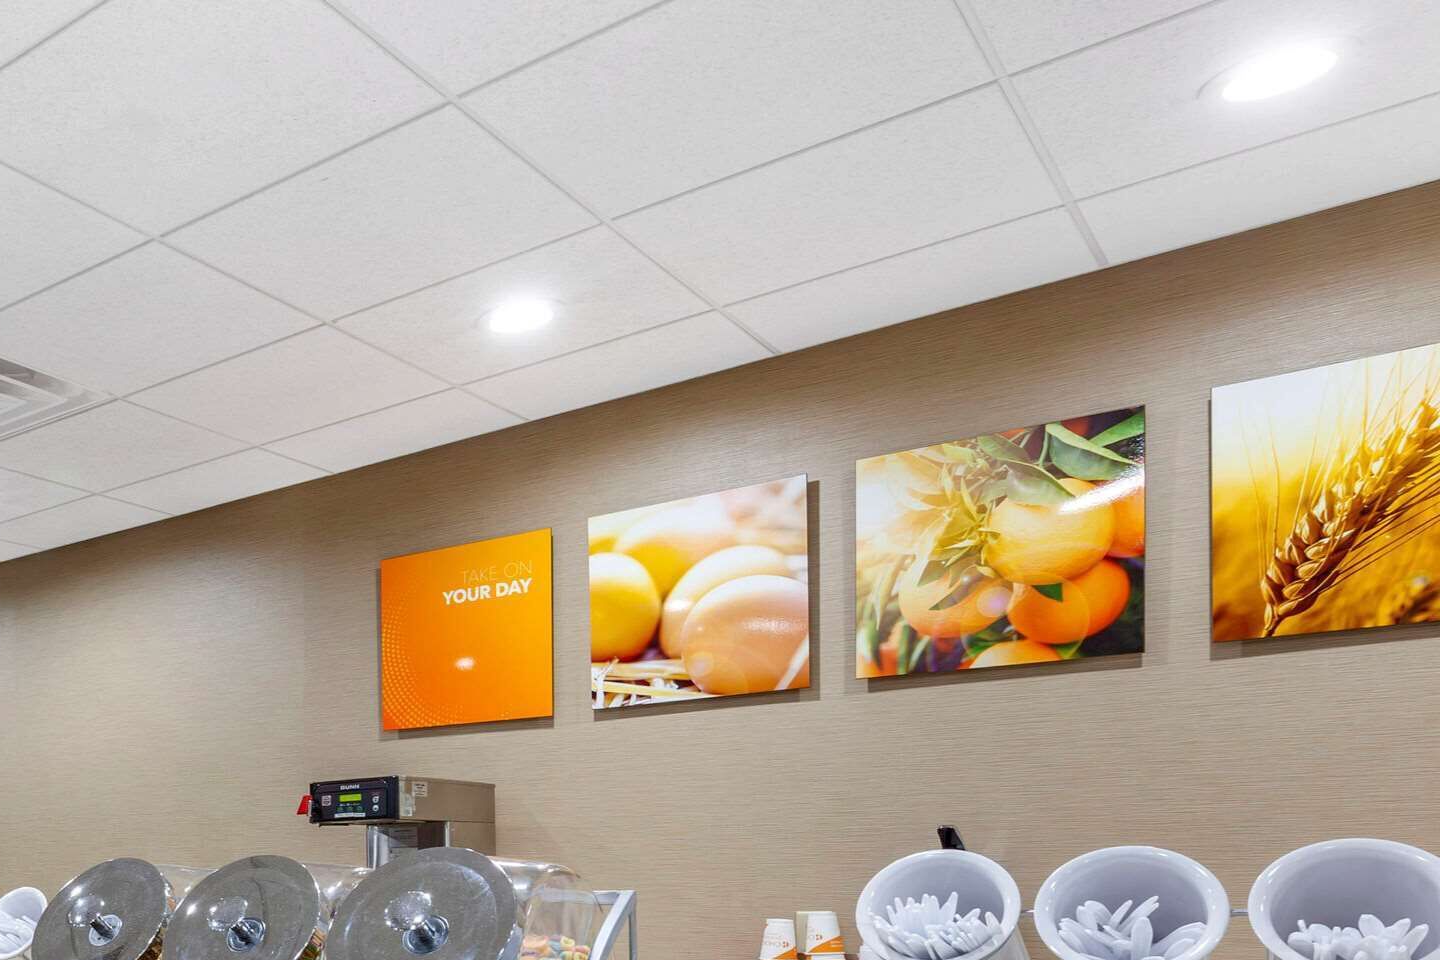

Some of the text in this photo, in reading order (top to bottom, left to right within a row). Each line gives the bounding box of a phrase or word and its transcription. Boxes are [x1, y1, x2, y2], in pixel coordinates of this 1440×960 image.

[461, 560, 533, 584] TAKE ON
[442, 577, 532, 605] YOUR DAY
